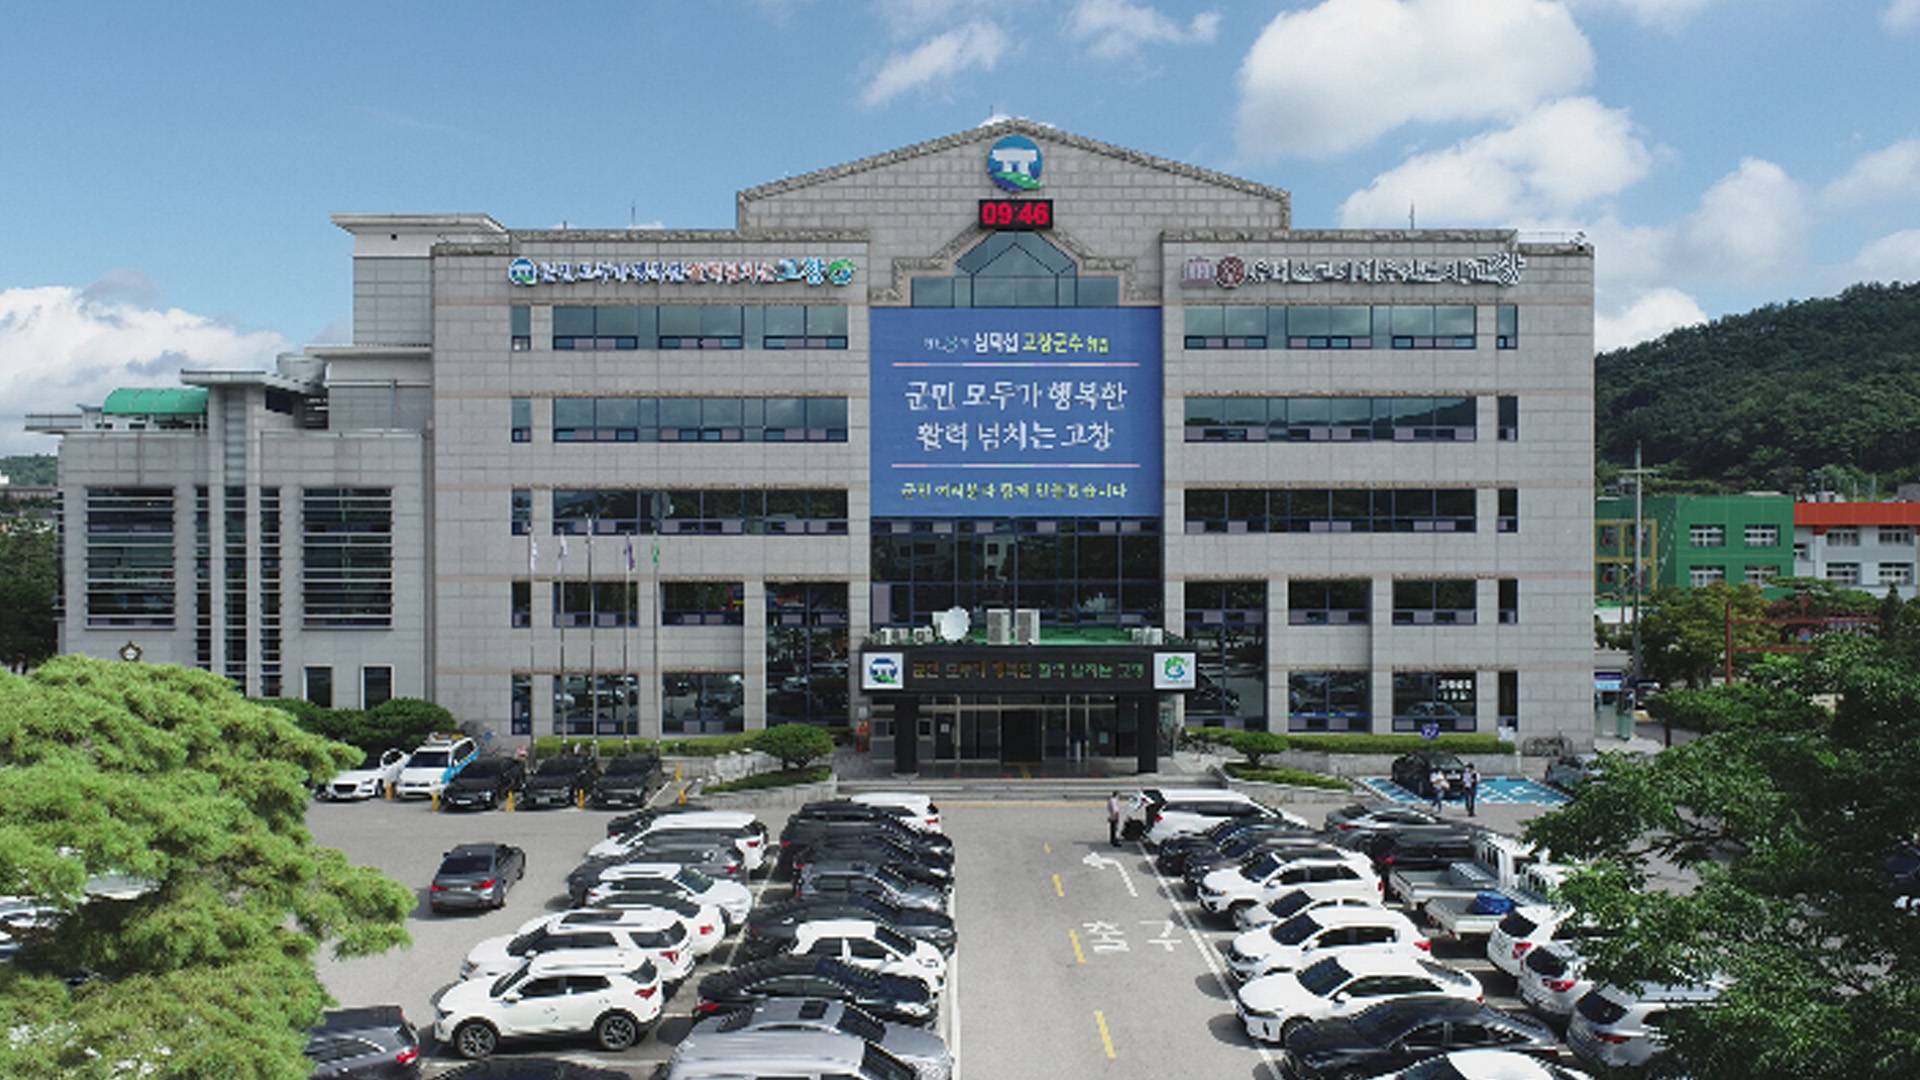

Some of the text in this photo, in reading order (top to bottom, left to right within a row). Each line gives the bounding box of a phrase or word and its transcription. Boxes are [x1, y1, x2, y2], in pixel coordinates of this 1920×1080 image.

[983, 202, 1049, 225] 09:46
[1022, 332, 1084, 354] 고창군수
[904, 381, 1128, 411] 군민 모두가 행복한
[916, 420, 1116, 452] 활력 넘치는 고창
